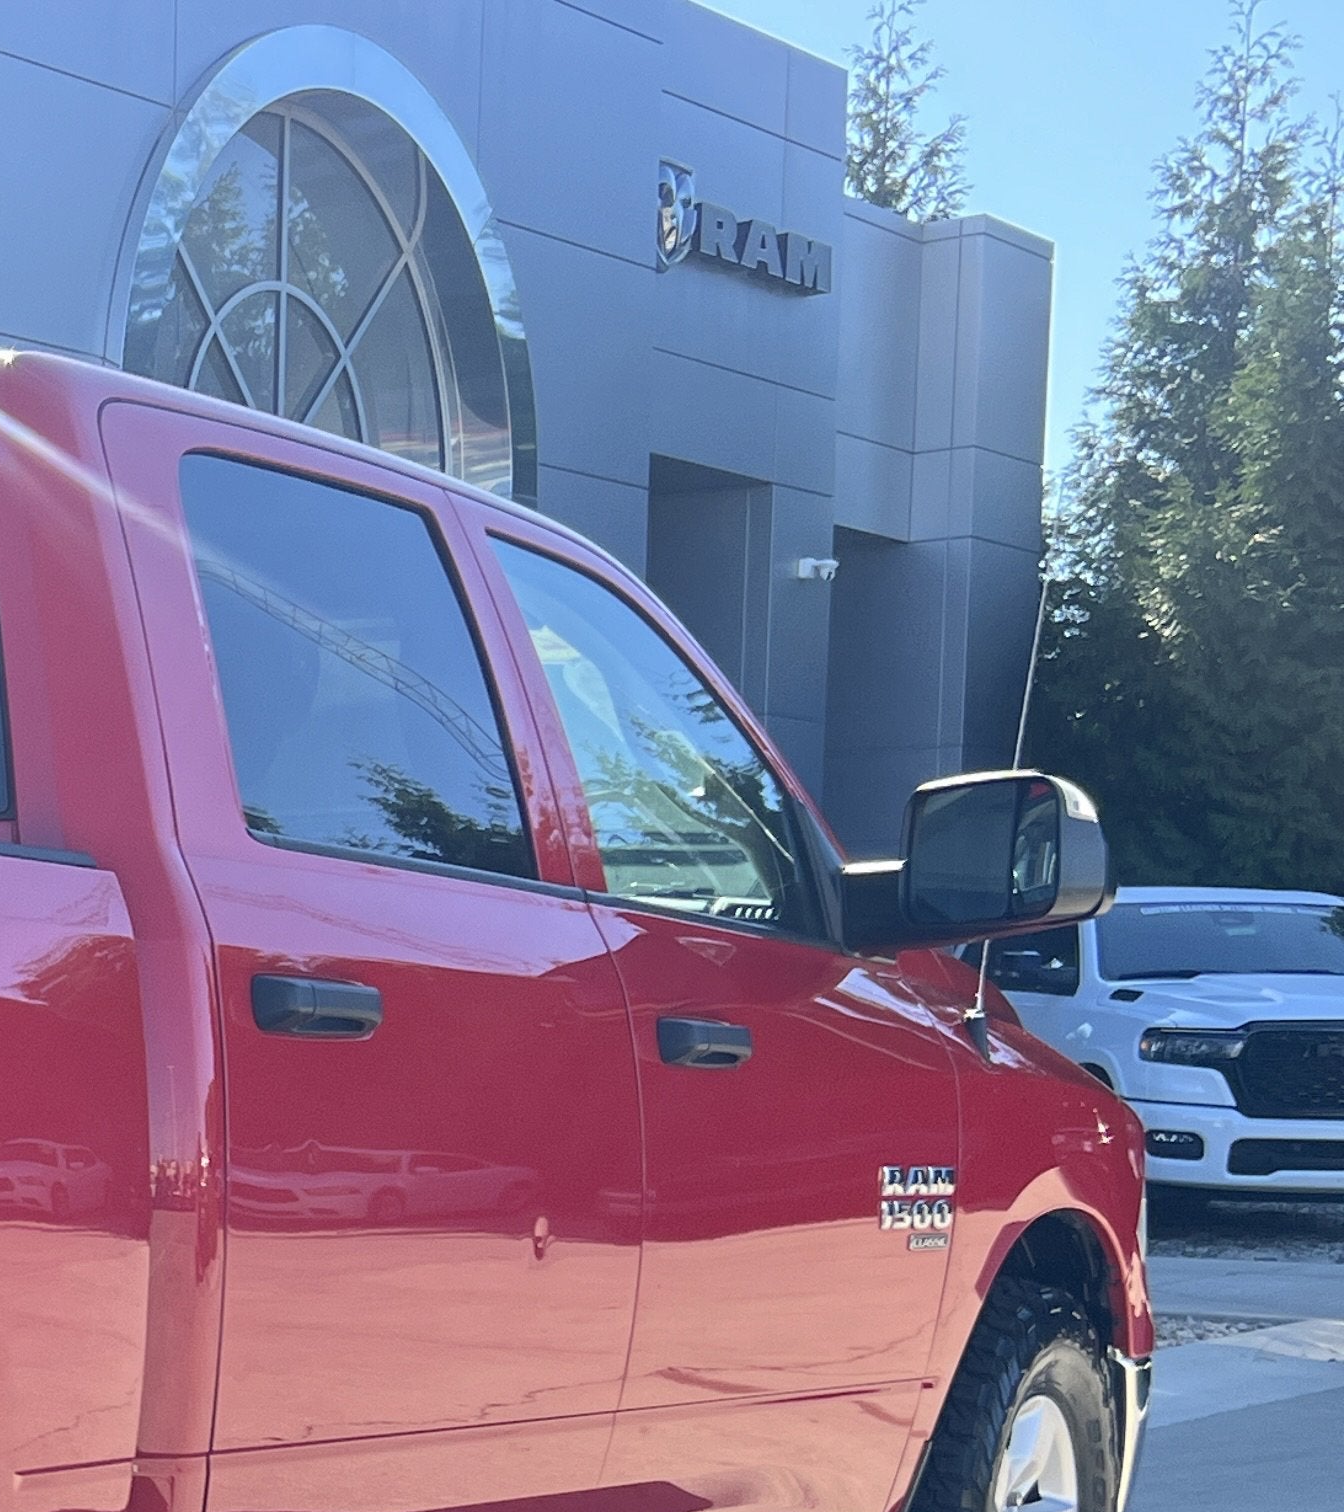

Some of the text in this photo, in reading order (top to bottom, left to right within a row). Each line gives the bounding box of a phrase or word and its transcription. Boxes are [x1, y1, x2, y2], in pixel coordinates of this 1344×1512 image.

[695, 201, 833, 294] RAM
[878, 1164, 956, 1197] RAM
[879, 1199, 954, 1231] 1500
